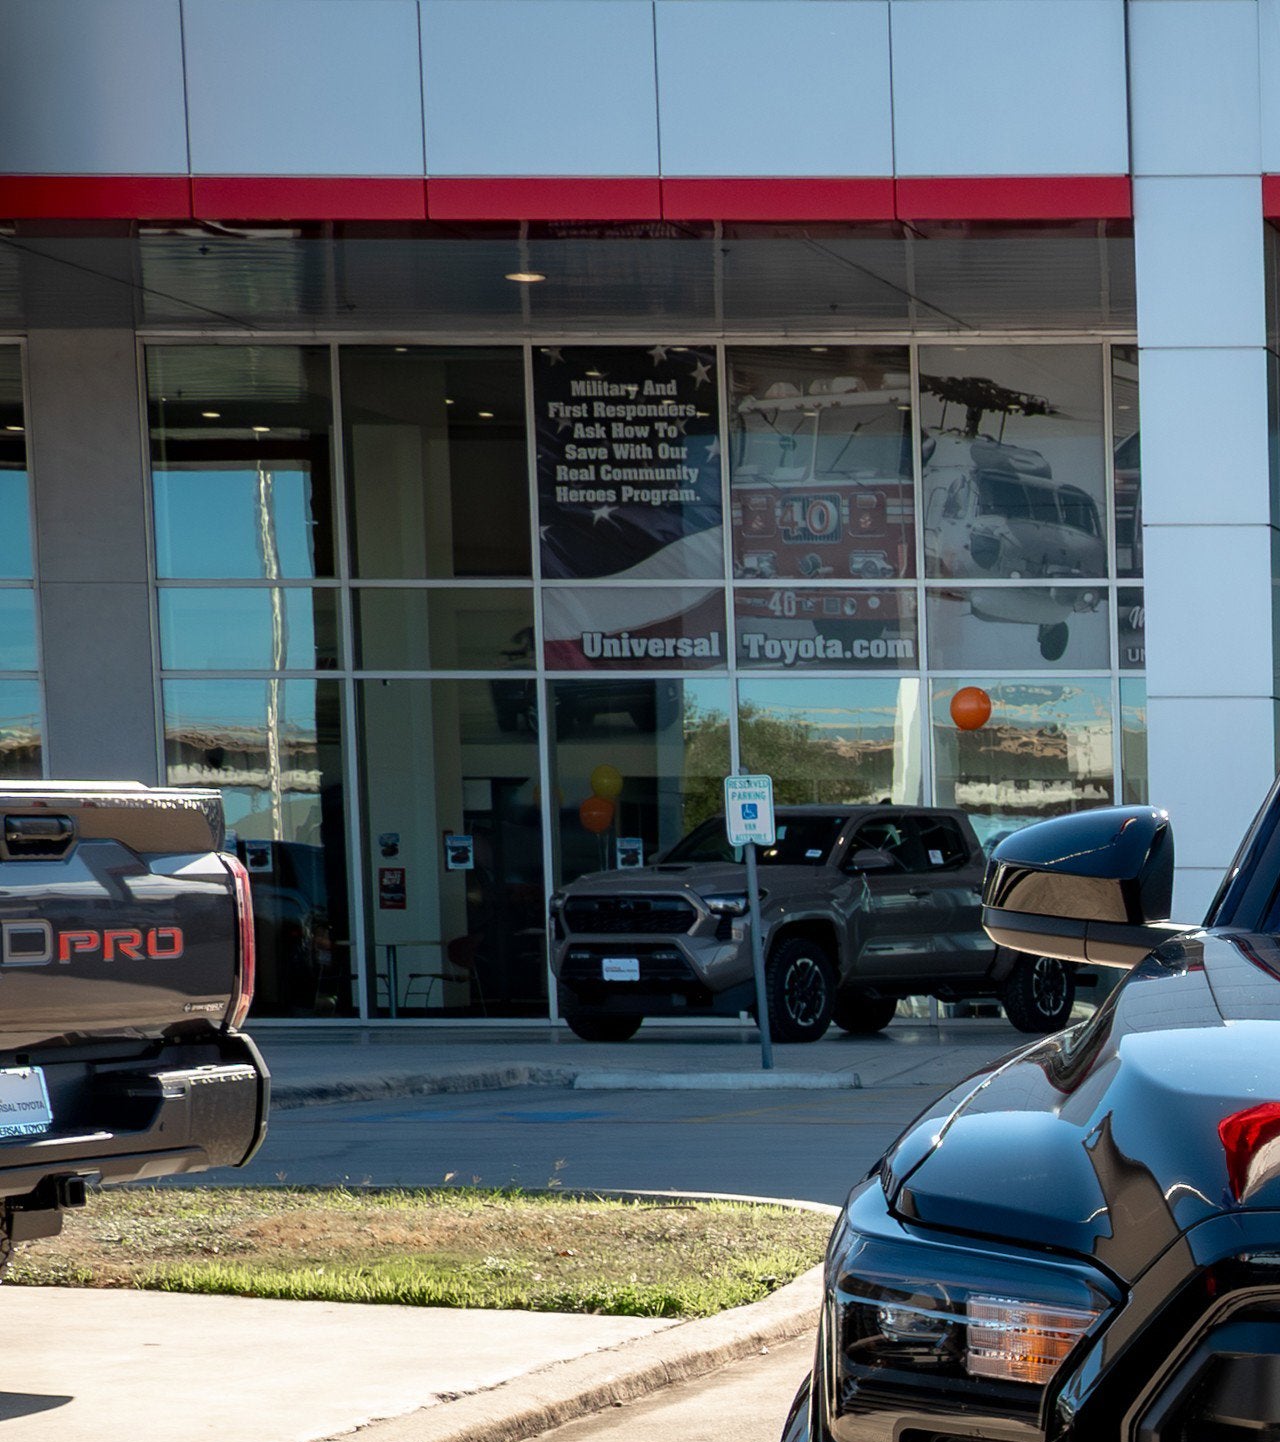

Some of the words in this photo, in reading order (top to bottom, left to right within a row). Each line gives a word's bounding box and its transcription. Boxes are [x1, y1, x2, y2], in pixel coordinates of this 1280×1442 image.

[570, 380, 638, 399] Military
[643, 380, 677, 396] And
[548, 402, 588, 418] First
[574, 423, 606, 438] Ask
[612, 422, 649, 438] How
[655, 422, 678, 438] To
[565, 444, 608, 459] Save
[612, 443, 653, 459] With
[658, 443, 688, 459] Our
[556, 465, 595, 481] Real
[600, 464, 699, 483] Community
[556, 486, 616, 502] Heroes
[622, 485, 701, 505] Program.
[779, 499, 838, 536] 40
[768, 590, 797, 617] 40
[582, 631, 721, 658] Universal
[743, 634, 914, 664] Toyota.com
[728, 780, 769, 789] RESERVED
[731, 791, 766, 800] PARKING
[58, 926, 184, 965] PRO
[17, 1101, 45, 1111] TOYOTA
